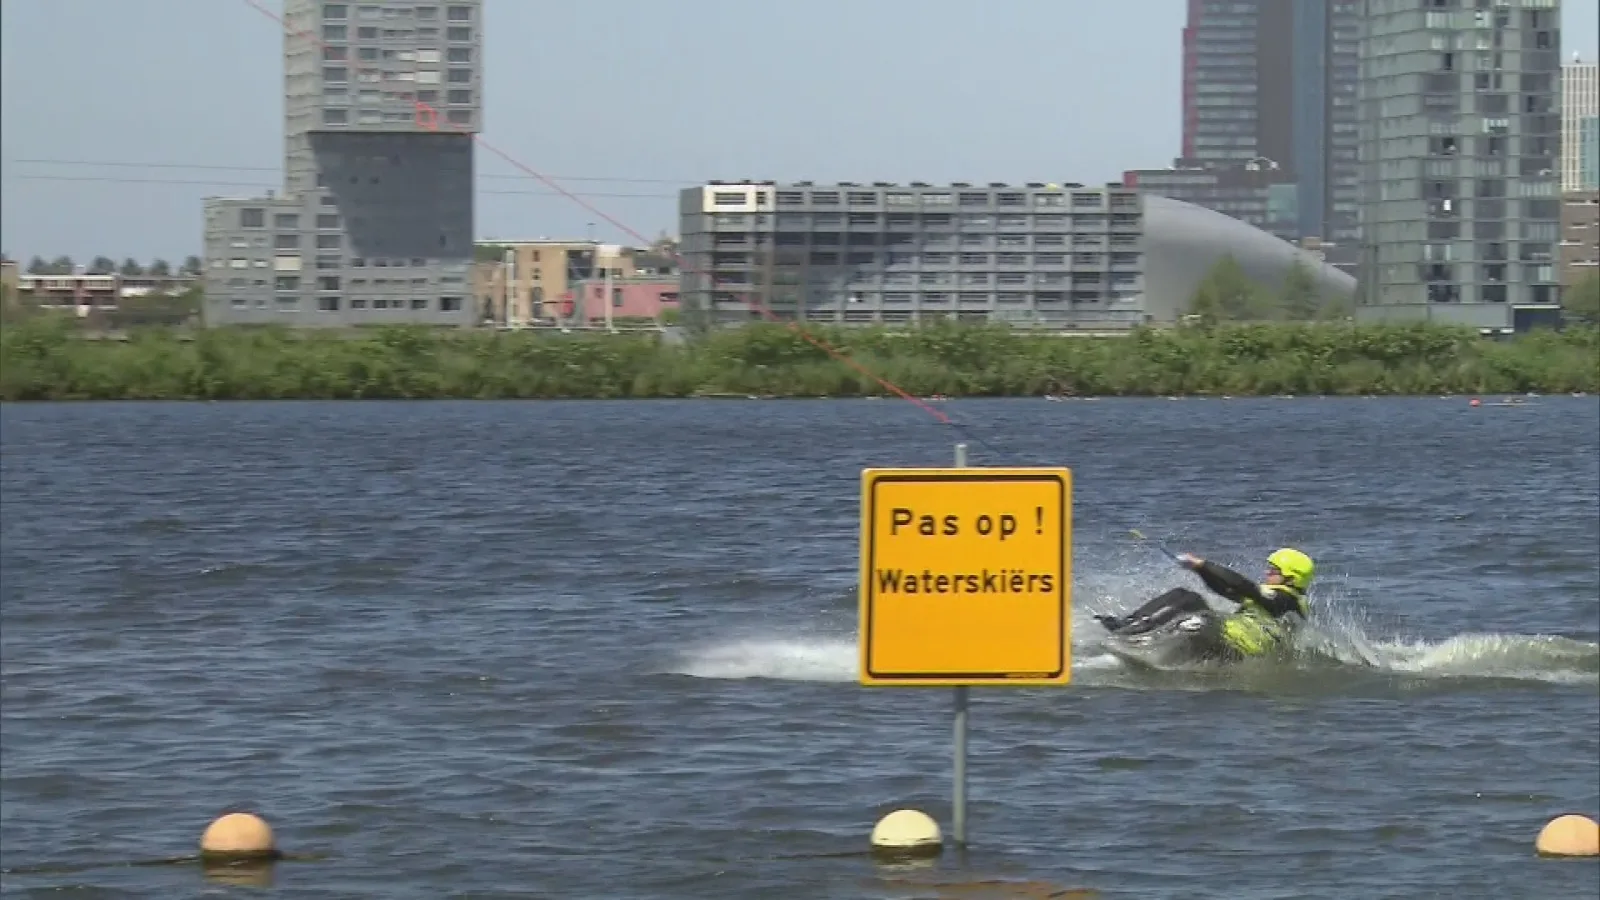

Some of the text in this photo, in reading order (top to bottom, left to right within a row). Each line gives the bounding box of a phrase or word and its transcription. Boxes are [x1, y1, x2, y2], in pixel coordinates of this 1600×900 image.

[890, 507, 1044, 541] Pas op !
[877, 569, 1054, 594] Waterskiërs
